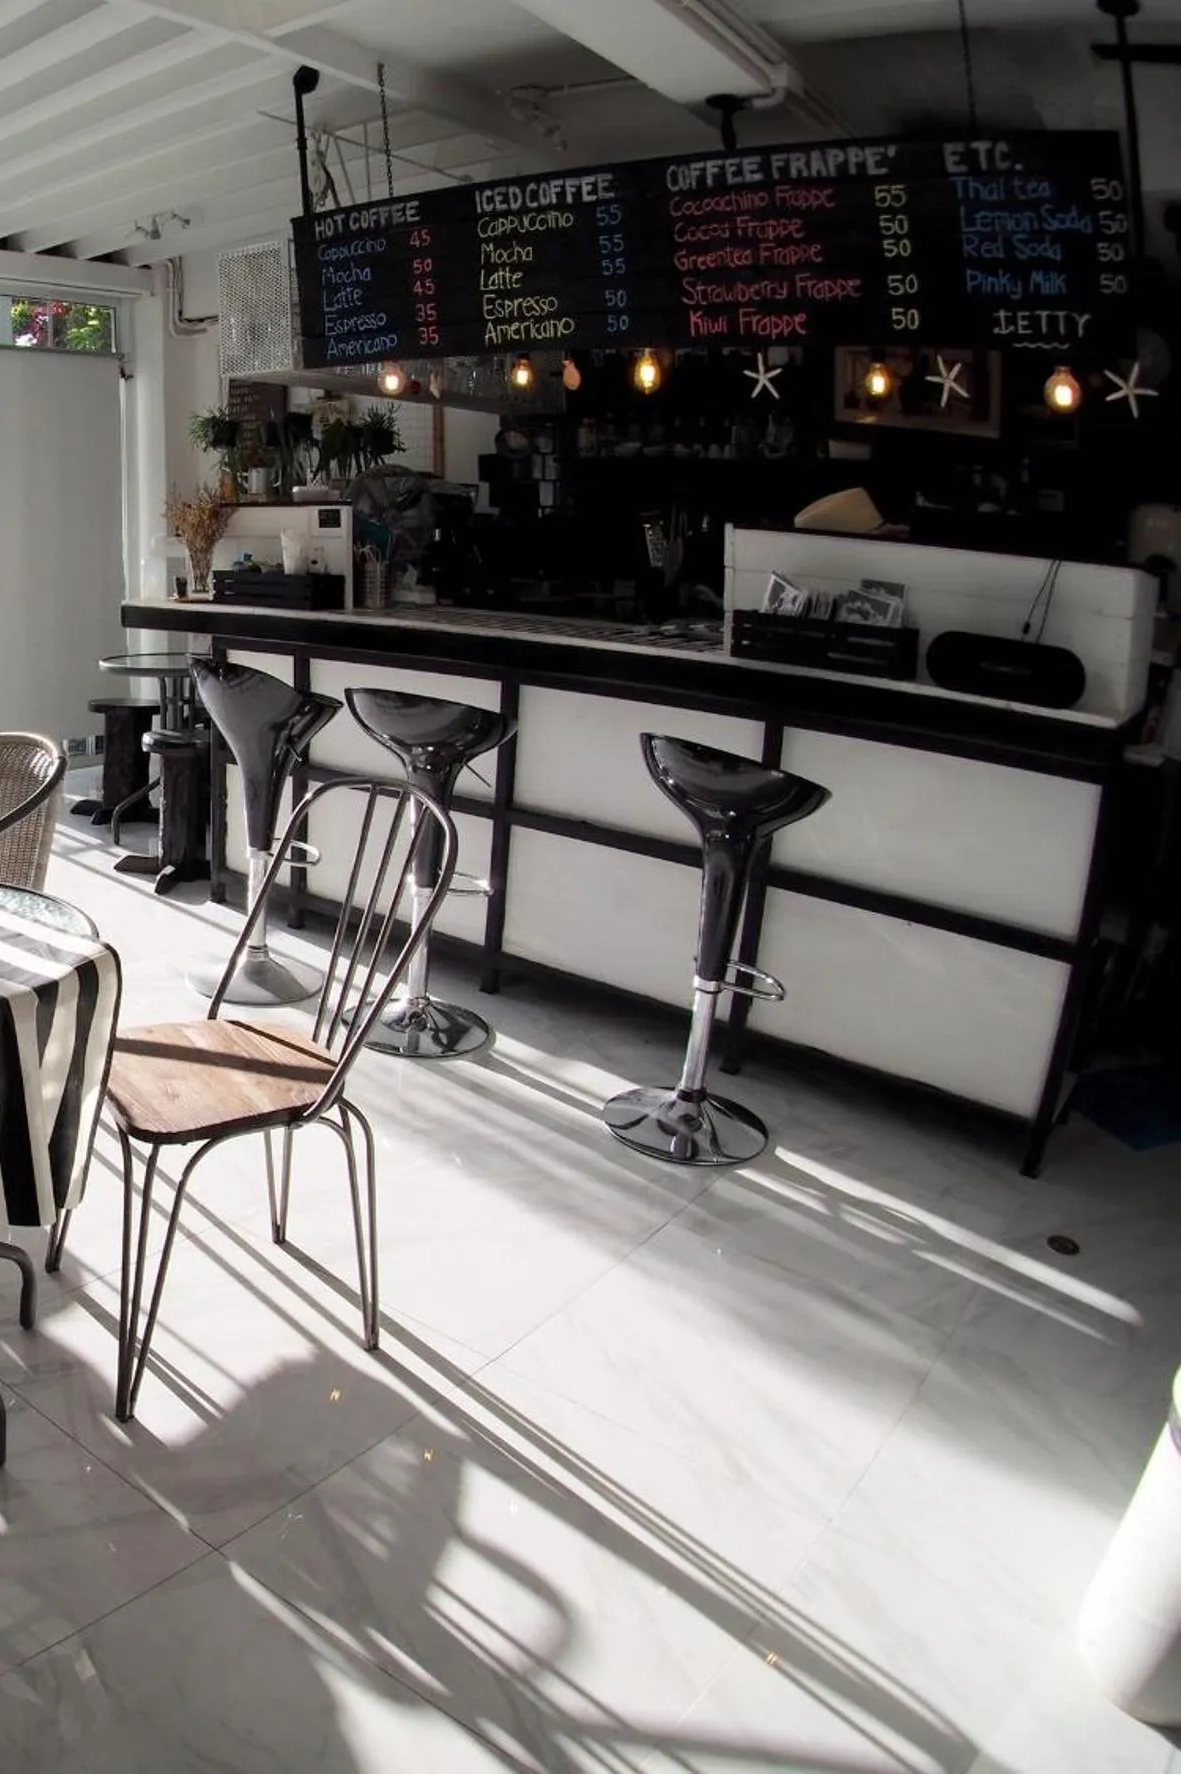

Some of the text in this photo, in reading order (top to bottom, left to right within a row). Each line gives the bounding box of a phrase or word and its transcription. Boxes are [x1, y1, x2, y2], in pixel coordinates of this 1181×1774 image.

[943, 140, 1023, 173] ETC.
[666, 155, 765, 192] COFFEE
[948, 176, 1123, 201] Thai tea 50
[474, 173, 615, 214] ICED COFFEE
[774, 185, 836, 211] Frappe
[874, 184, 908, 208] 55
[314, 201, 421, 240] HOT COFFEE
[595, 204, 623, 226] 55
[673, 215, 909, 243] Cocoa Frappe 50
[960, 204, 1128, 235] Lemon Soda 50
[409, 228, 431, 248] 45
[480, 234, 624, 265] Mocha 55
[961, 233, 1124, 263] Red Soda 50
[673, 238, 912, 272] Greentea Frappe 50
[321, 258, 433, 286] Mocha 50
[480, 258, 626, 291] Latte 55
[965, 268, 1127, 299] Pinky Milk 50
[323, 278, 435, 312] Latte 45
[482, 289, 627, 319] Espresso 50
[681, 272, 918, 306] Strawberry Frappe 50
[324, 303, 437, 337] Espresso 35
[484, 315, 629, 346] Americano 50
[689, 307, 919, 340] Kiwi Frappe 50
[326, 326, 439, 359] Americano 35
